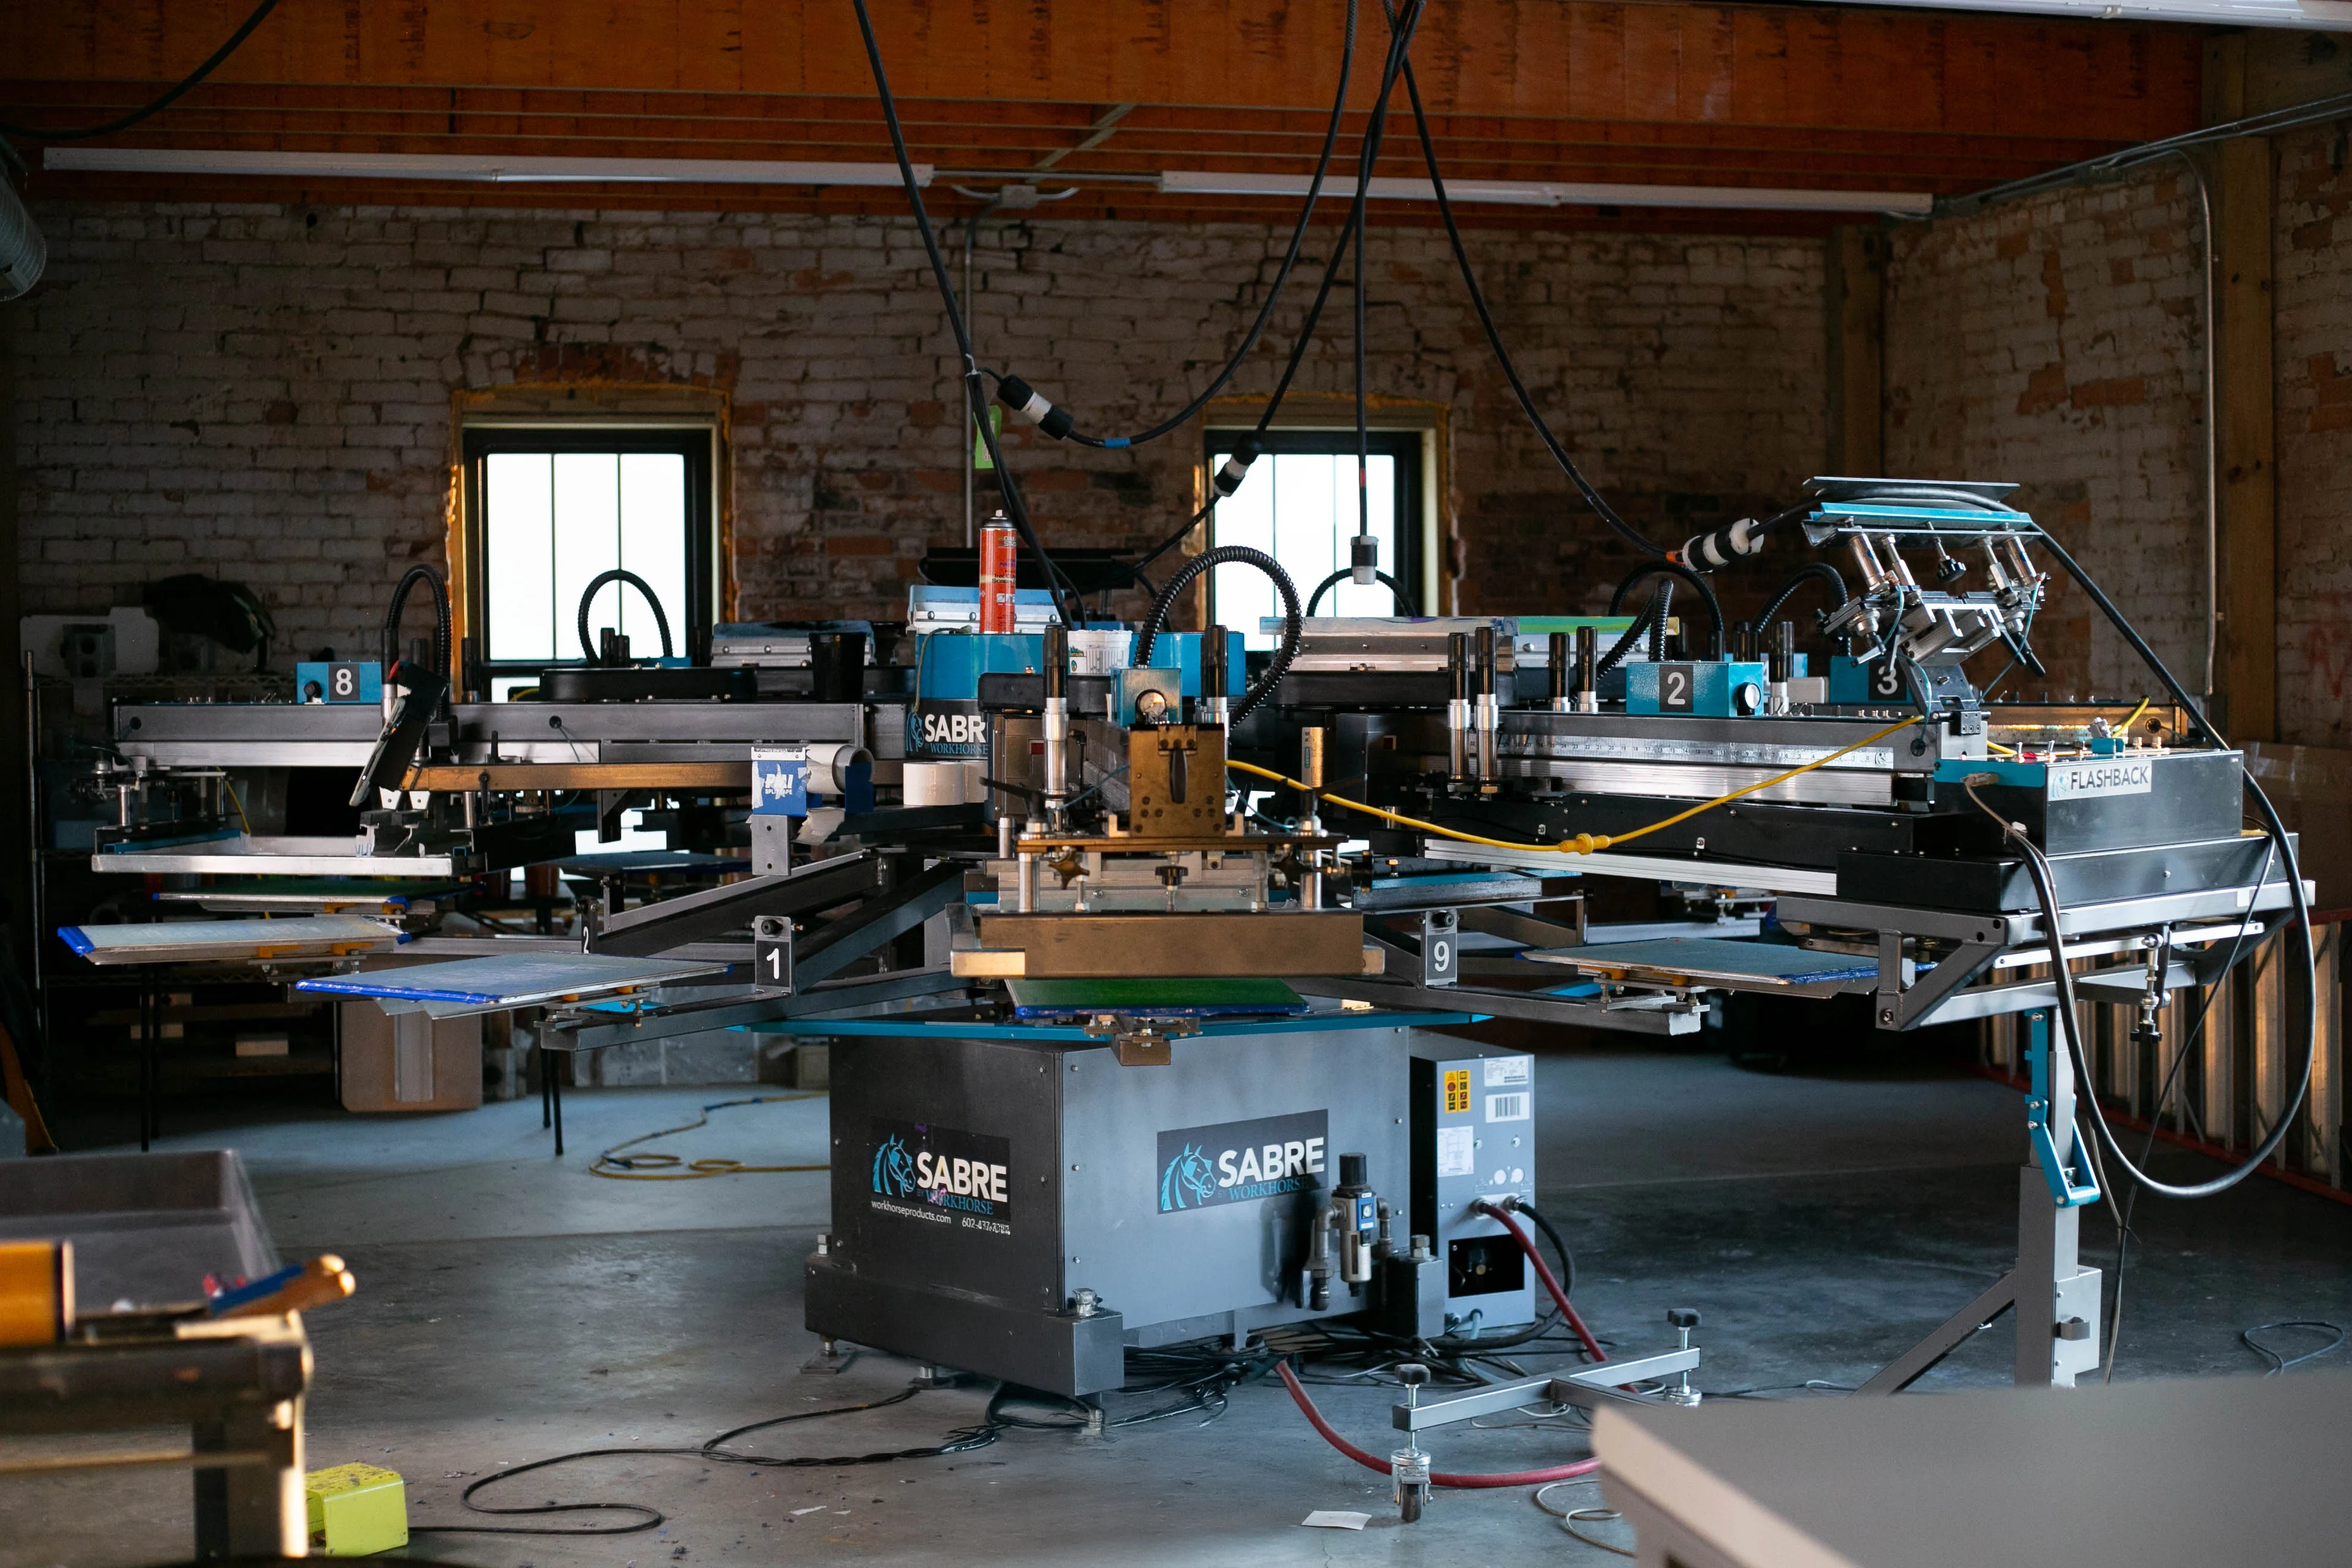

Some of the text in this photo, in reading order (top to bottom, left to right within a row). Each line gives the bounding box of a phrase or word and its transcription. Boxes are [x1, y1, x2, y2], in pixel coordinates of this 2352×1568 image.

[336, 668, 353, 696] 8
[1667, 672, 1686, 705] 2
[1877, 665, 1898, 695] 3
[925, 713, 988, 743] SABR
[930, 743, 989, 754] WORKHORSE
[2071, 766, 2149, 790] FLASHBACK
[583, 926, 589, 954] 2
[766, 947, 779, 979] 1
[1434, 941, 1450, 972] 9
[917, 1152, 1008, 1203] SABRE
[1218, 1137, 1324, 1188] SABRE
[871, 1200, 951, 1224] workhorseproducts.com
